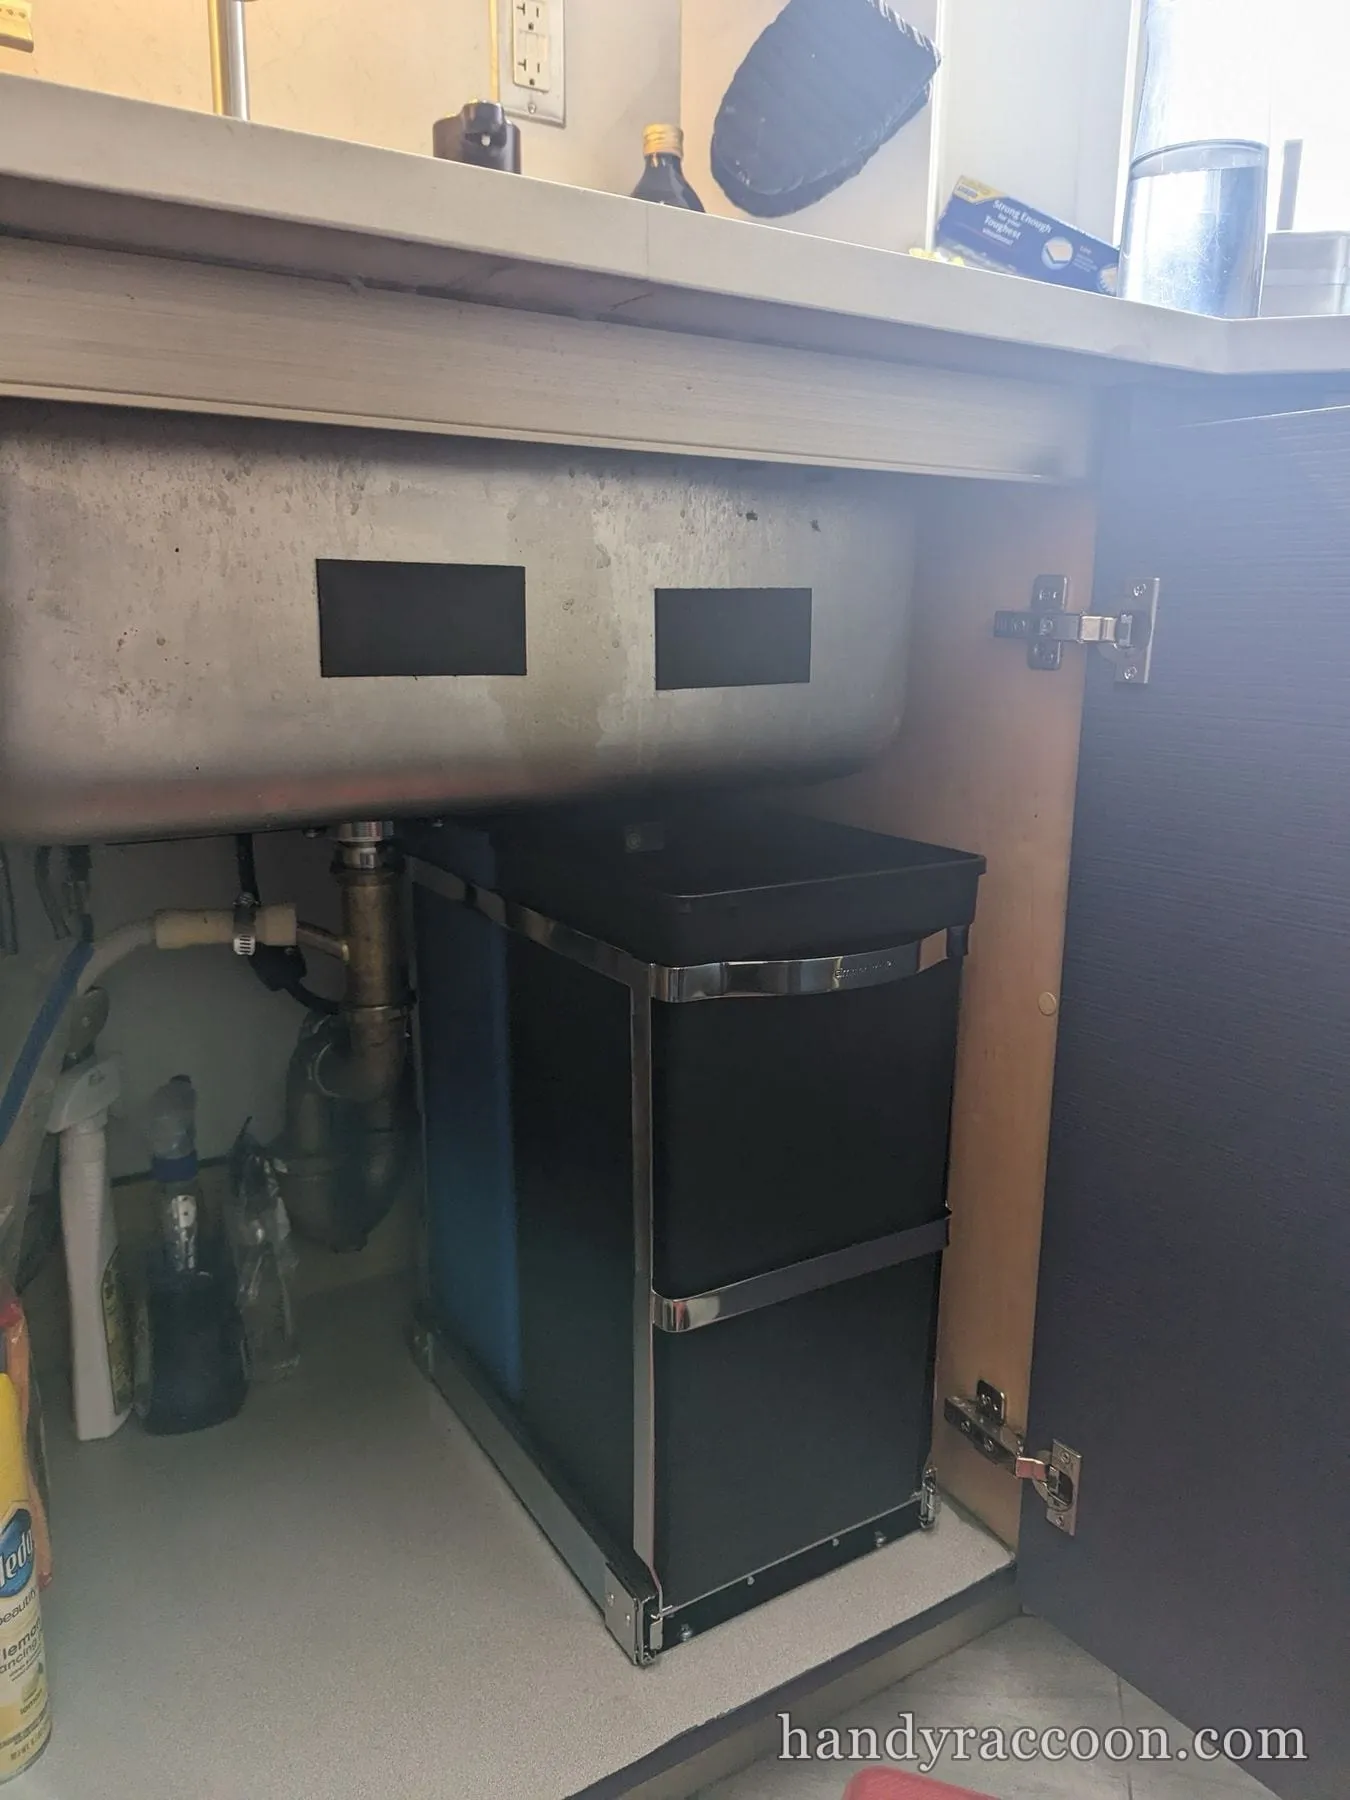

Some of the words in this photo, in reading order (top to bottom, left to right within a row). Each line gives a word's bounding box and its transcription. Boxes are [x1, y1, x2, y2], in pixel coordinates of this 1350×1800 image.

[984, 215, 1021, 240] Toughest
[992, 199, 1021, 220] Strong
[1021, 211, 1053, 233] Enough
